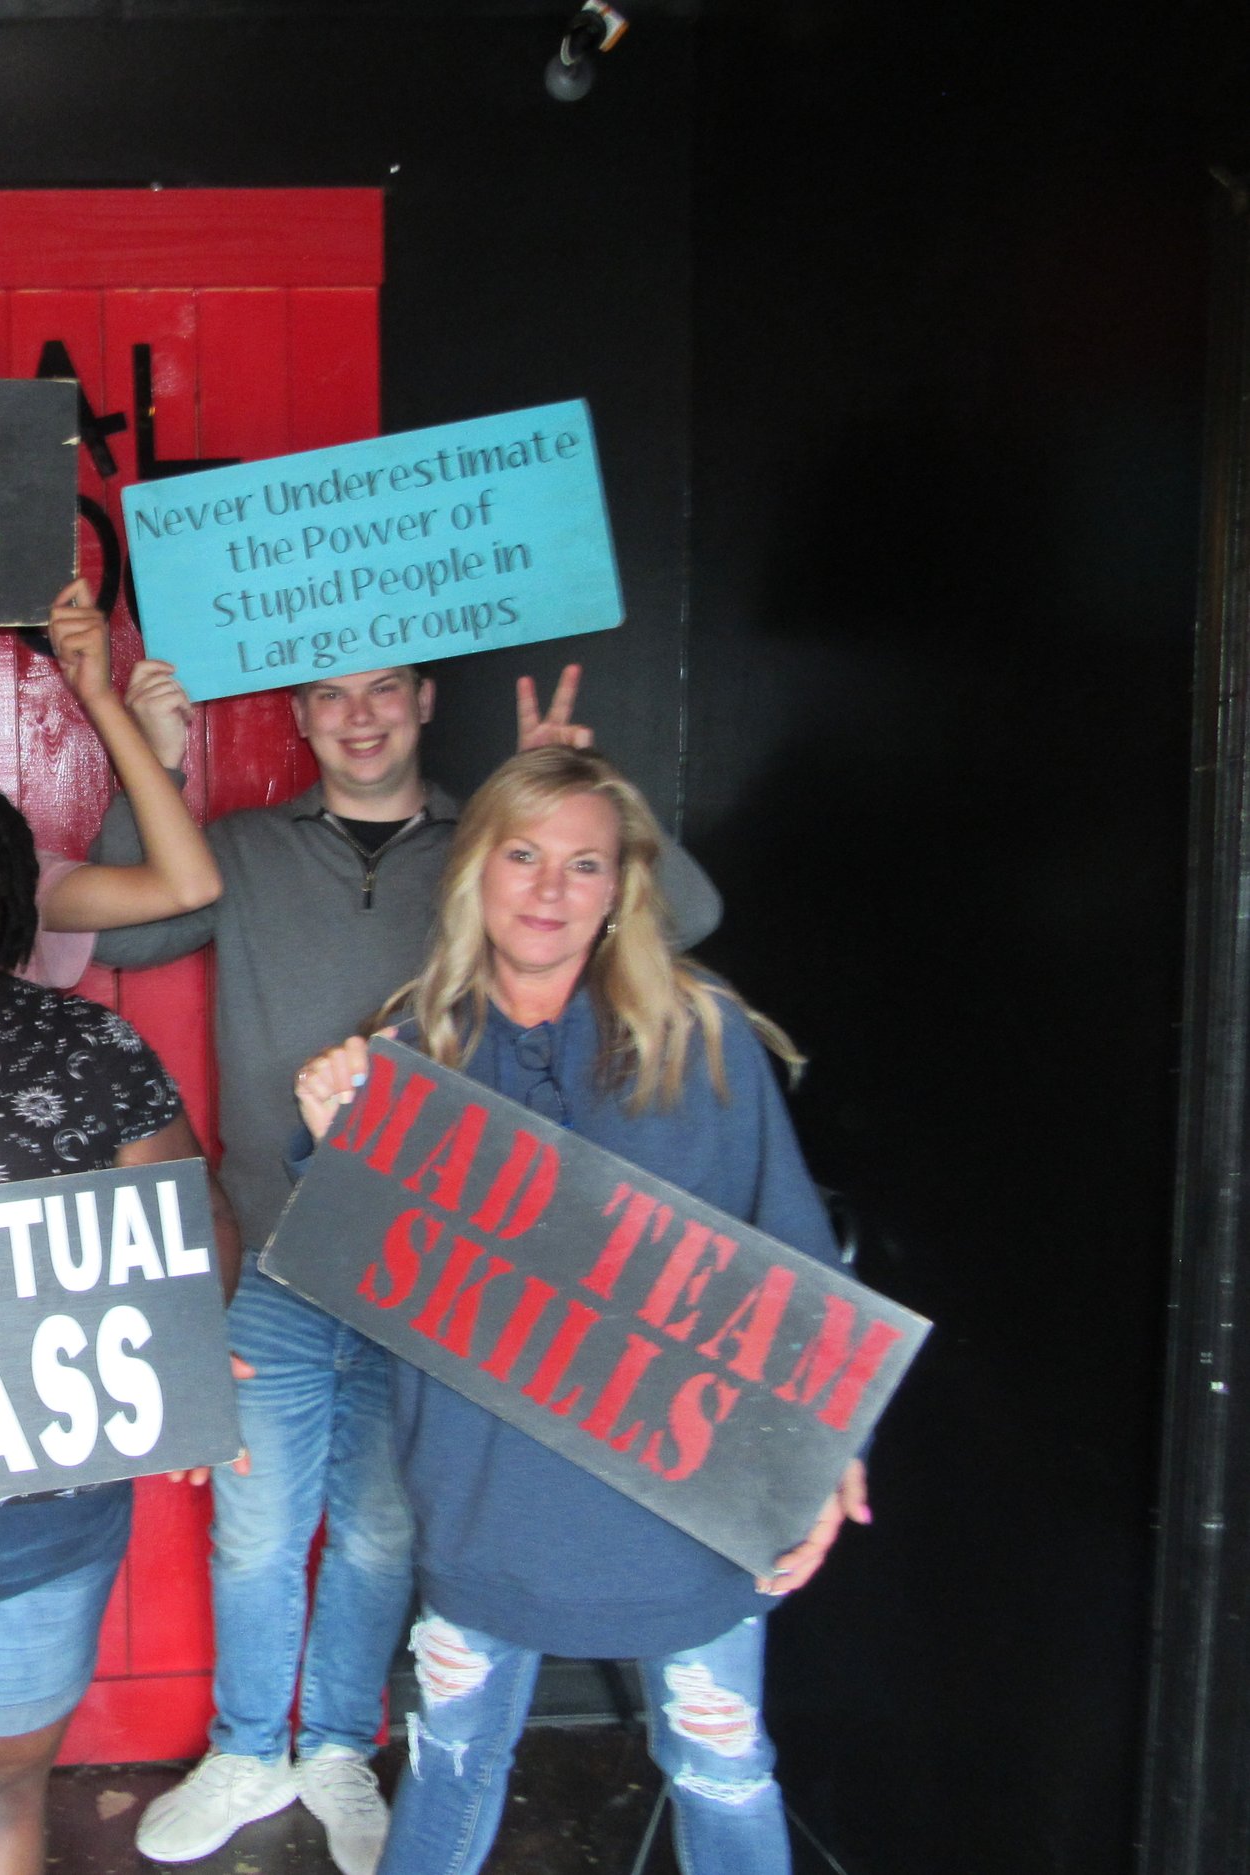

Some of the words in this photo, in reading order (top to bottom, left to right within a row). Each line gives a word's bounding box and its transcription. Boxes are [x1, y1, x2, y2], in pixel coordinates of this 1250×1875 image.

[134, 492, 254, 541] Never
[263, 428, 580, 516] Underestimate
[226, 535, 294, 576] the
[301, 508, 438, 560] Power
[450, 488, 496, 530] of
[211, 571, 343, 628] Stupid
[351, 550, 484, 600] People
[493, 540, 531, 575] in
[237, 624, 358, 674] Large
[369, 596, 520, 649] Groups
[330, 1052, 562, 1241] MAD
[579, 1182, 904, 1432] TEAM
[357, 1207, 742, 1482] SKILLS
